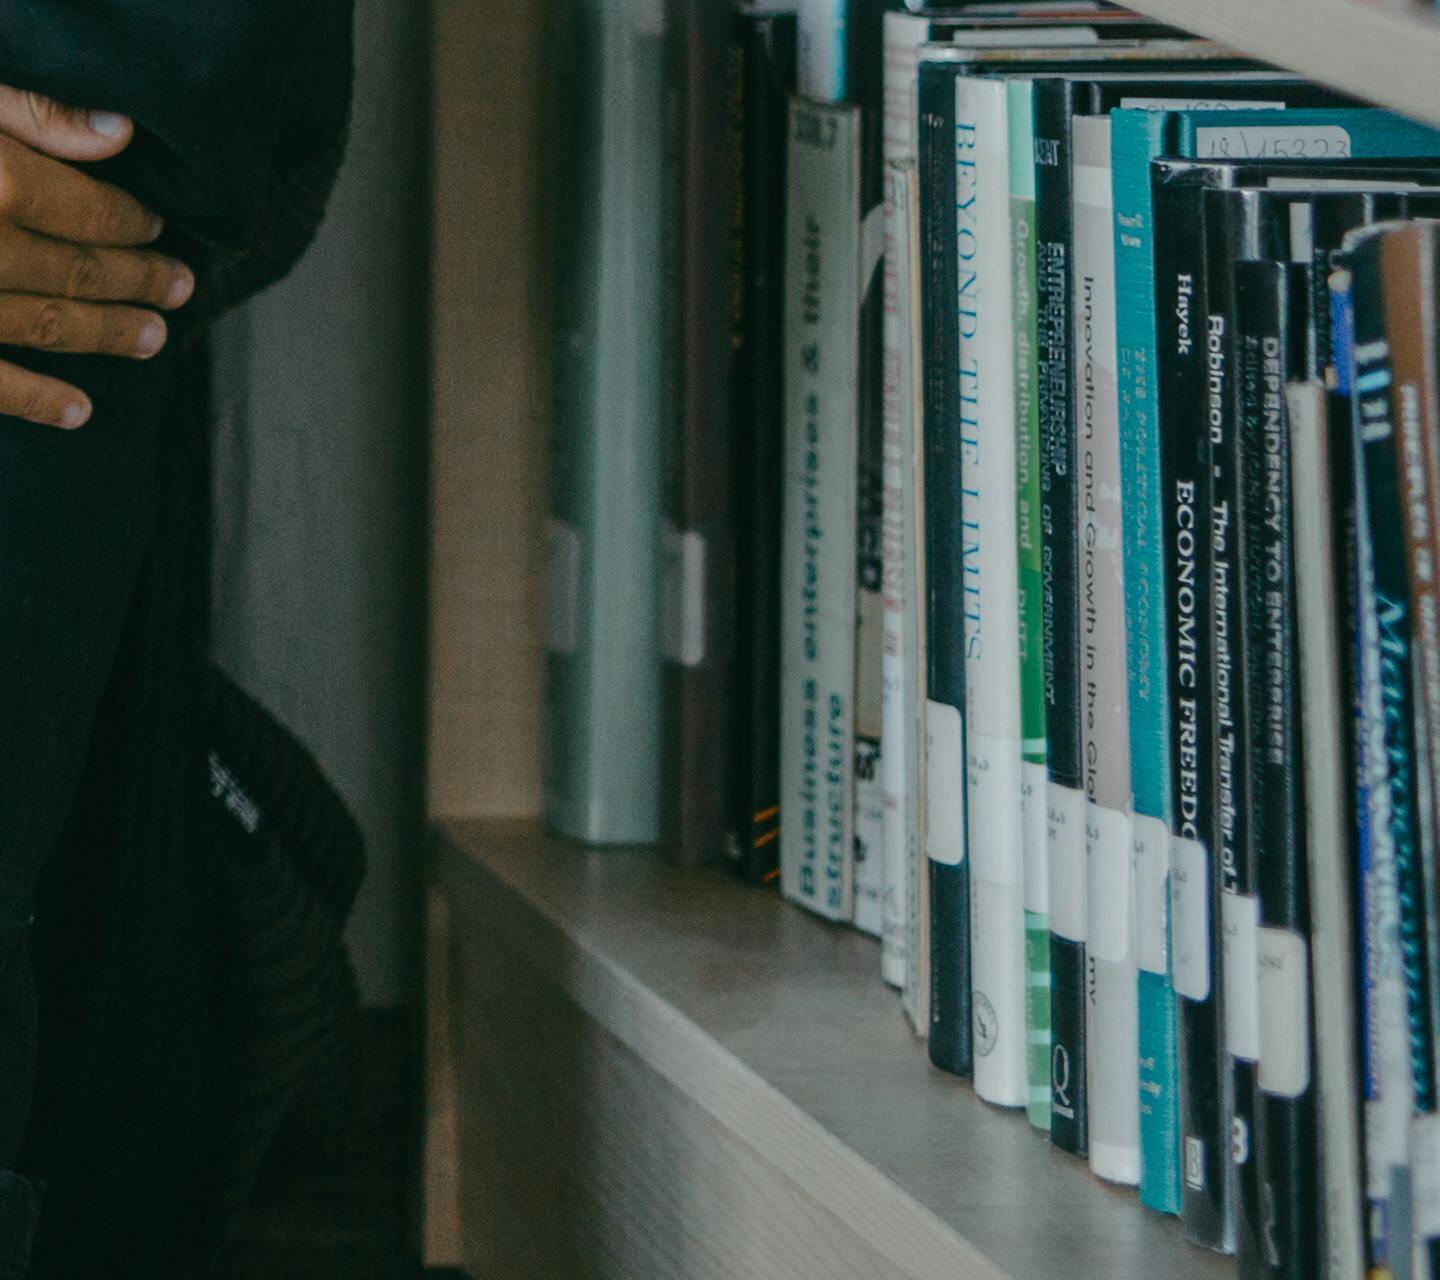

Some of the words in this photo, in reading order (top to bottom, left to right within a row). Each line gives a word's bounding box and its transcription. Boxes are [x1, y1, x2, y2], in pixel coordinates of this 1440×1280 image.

[956, 118, 979, 341] BEYOND
[1083, 276, 1096, 442] Innovation
[1175, 271, 1192, 355] Hayek
[1207, 313, 1225, 444] Robinson
[959, 357, 980, 468] THE
[1084, 450, 1096, 512] and
[1262, 336, 1282, 532] DEPENDENCY
[800, 394, 822, 663] enterprises
[960, 486, 983, 663] LIMITS
[1084, 520, 1098, 636] Growth
[1175, 478, 1196, 689] ECONOMIC
[1212, 500, 1229, 553] The
[1264, 539, 1282, 582] TO
[1086, 680, 1098, 730] the
[1214, 559, 1234, 727] International
[1265, 591, 1285, 765] ENTERPRISE
[800, 678, 818, 898] Business
[825, 691, 844, 909] structure
[1179, 696, 1198, 842] FREEDO
[1219, 730, 1237, 840] Transfer
[1222, 846, 1238, 879] of
